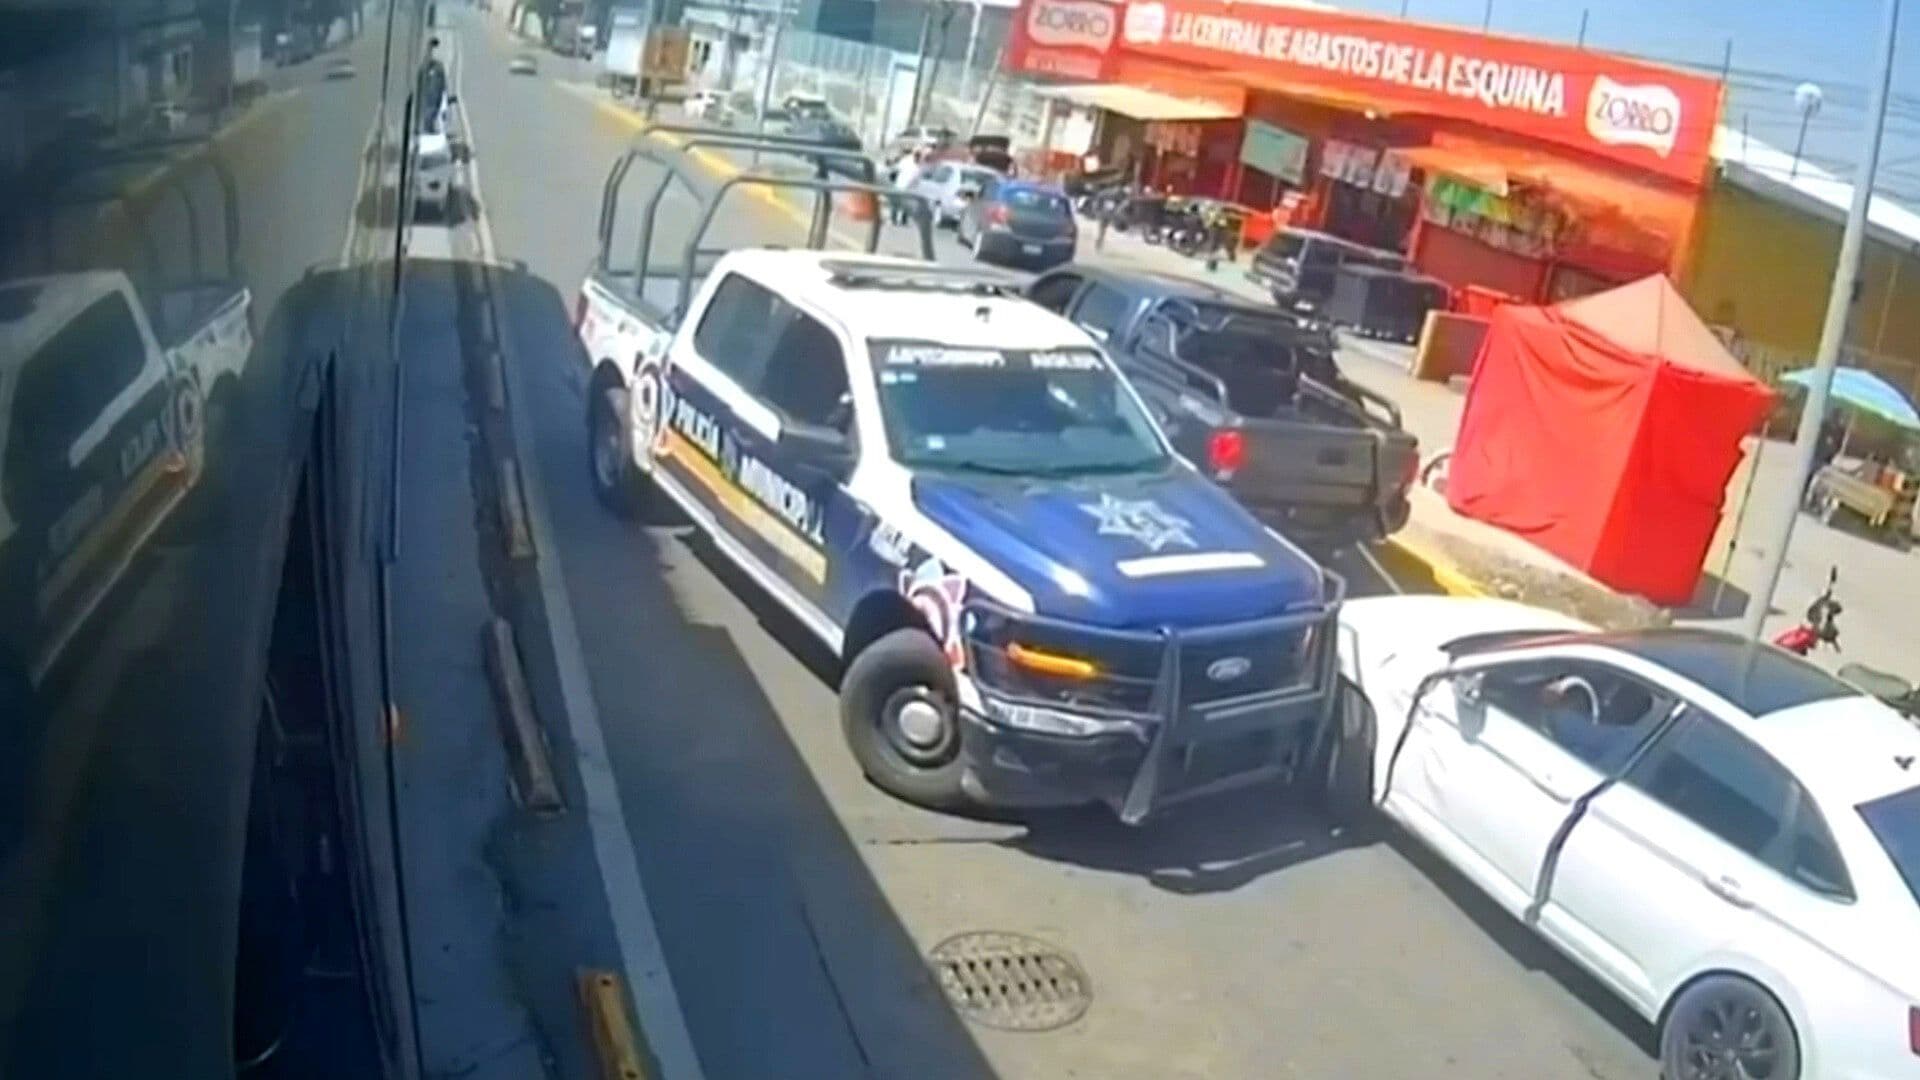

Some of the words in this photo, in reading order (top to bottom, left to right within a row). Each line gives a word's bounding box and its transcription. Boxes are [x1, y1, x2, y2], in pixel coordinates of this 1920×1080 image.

[1034, 4, 1110, 39] ZORRO
[1171, 11, 1194, 44] LA
[1192, 14, 1262, 56] CENTRAL
[1262, 23, 1291, 61] DE
[1287, 27, 1383, 79] ABASTOS
[1379, 40, 1412, 85] DE
[1411, 46, 1446, 92] LA
[1446, 54, 1566, 117] ESQUINA
[1594, 90, 1674, 137] ZORRO
